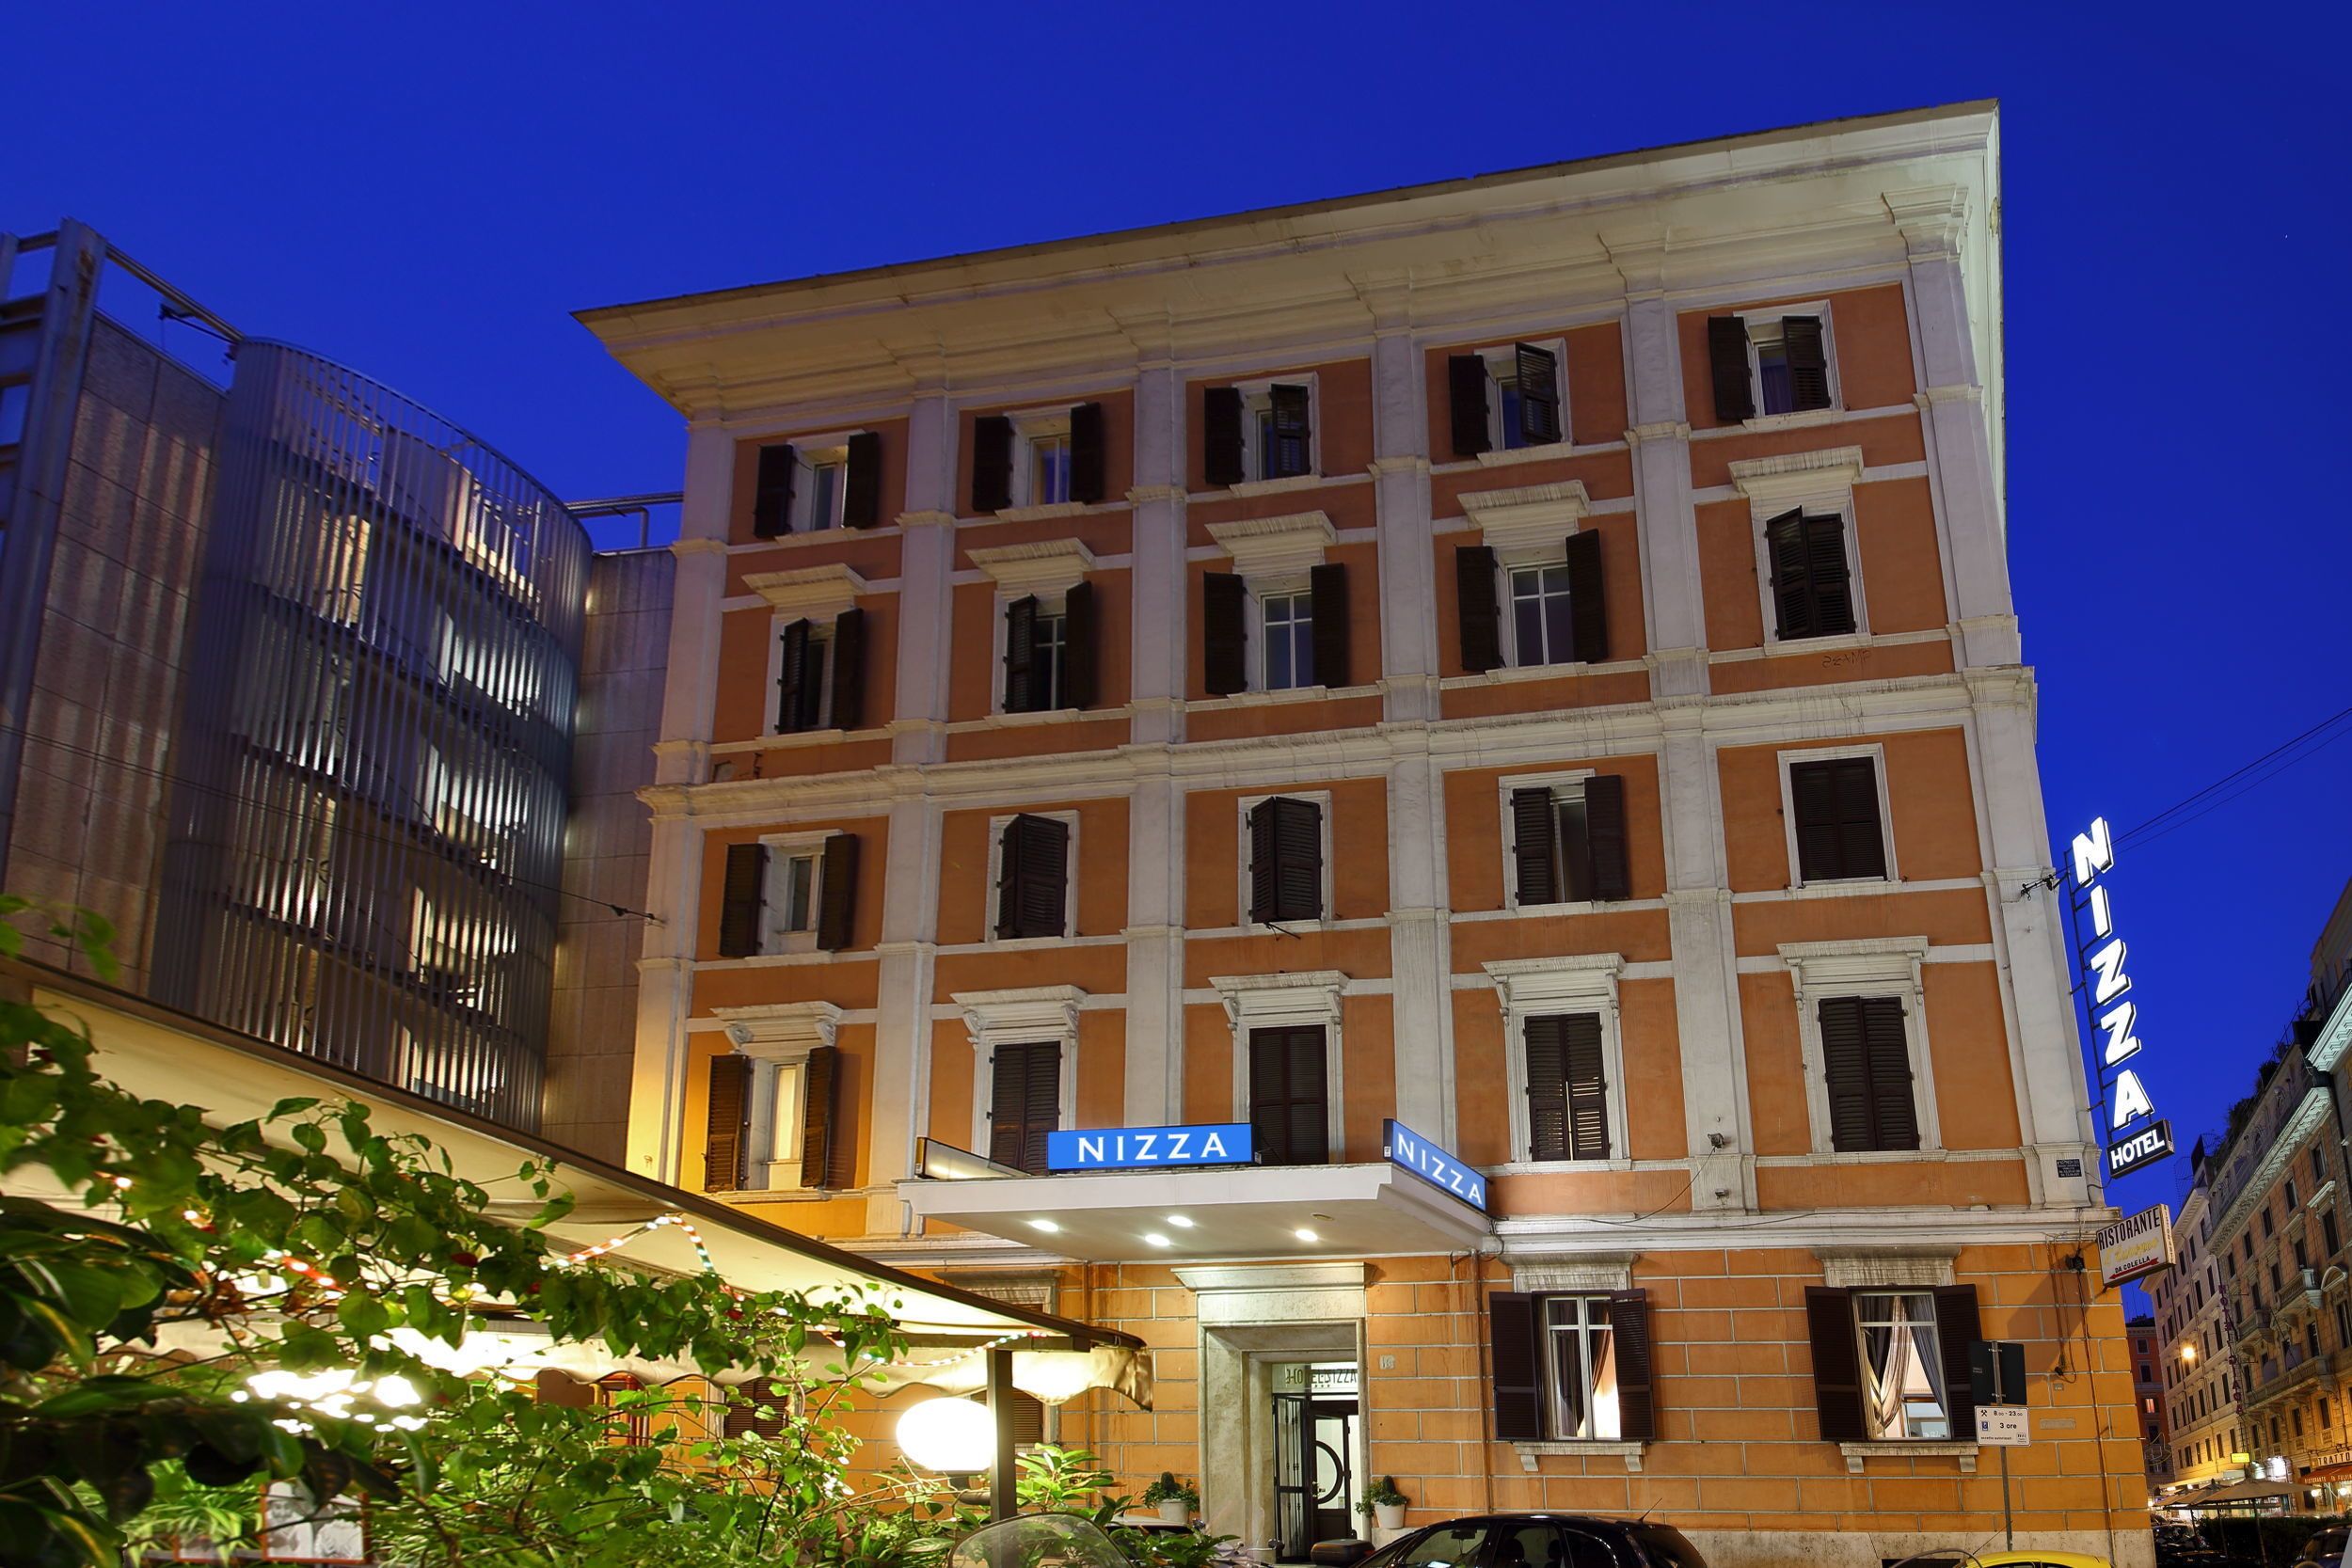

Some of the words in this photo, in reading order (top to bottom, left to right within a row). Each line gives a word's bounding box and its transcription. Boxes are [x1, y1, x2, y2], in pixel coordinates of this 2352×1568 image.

[2073, 816, 2154, 1130] NIZZA
[1077, 1132, 1228, 1163] NIZZA
[2110, 1129, 2166, 1169] HOTEL
[1398, 1132, 1483, 1205] NIZZA
[2098, 1207, 2160, 1251] RISTORANTE
[2115, 1265, 2122, 1274] DA
[2123, 1256, 2151, 1270] COLELLA
[1285, 1369, 1323, 1385] HOEL
